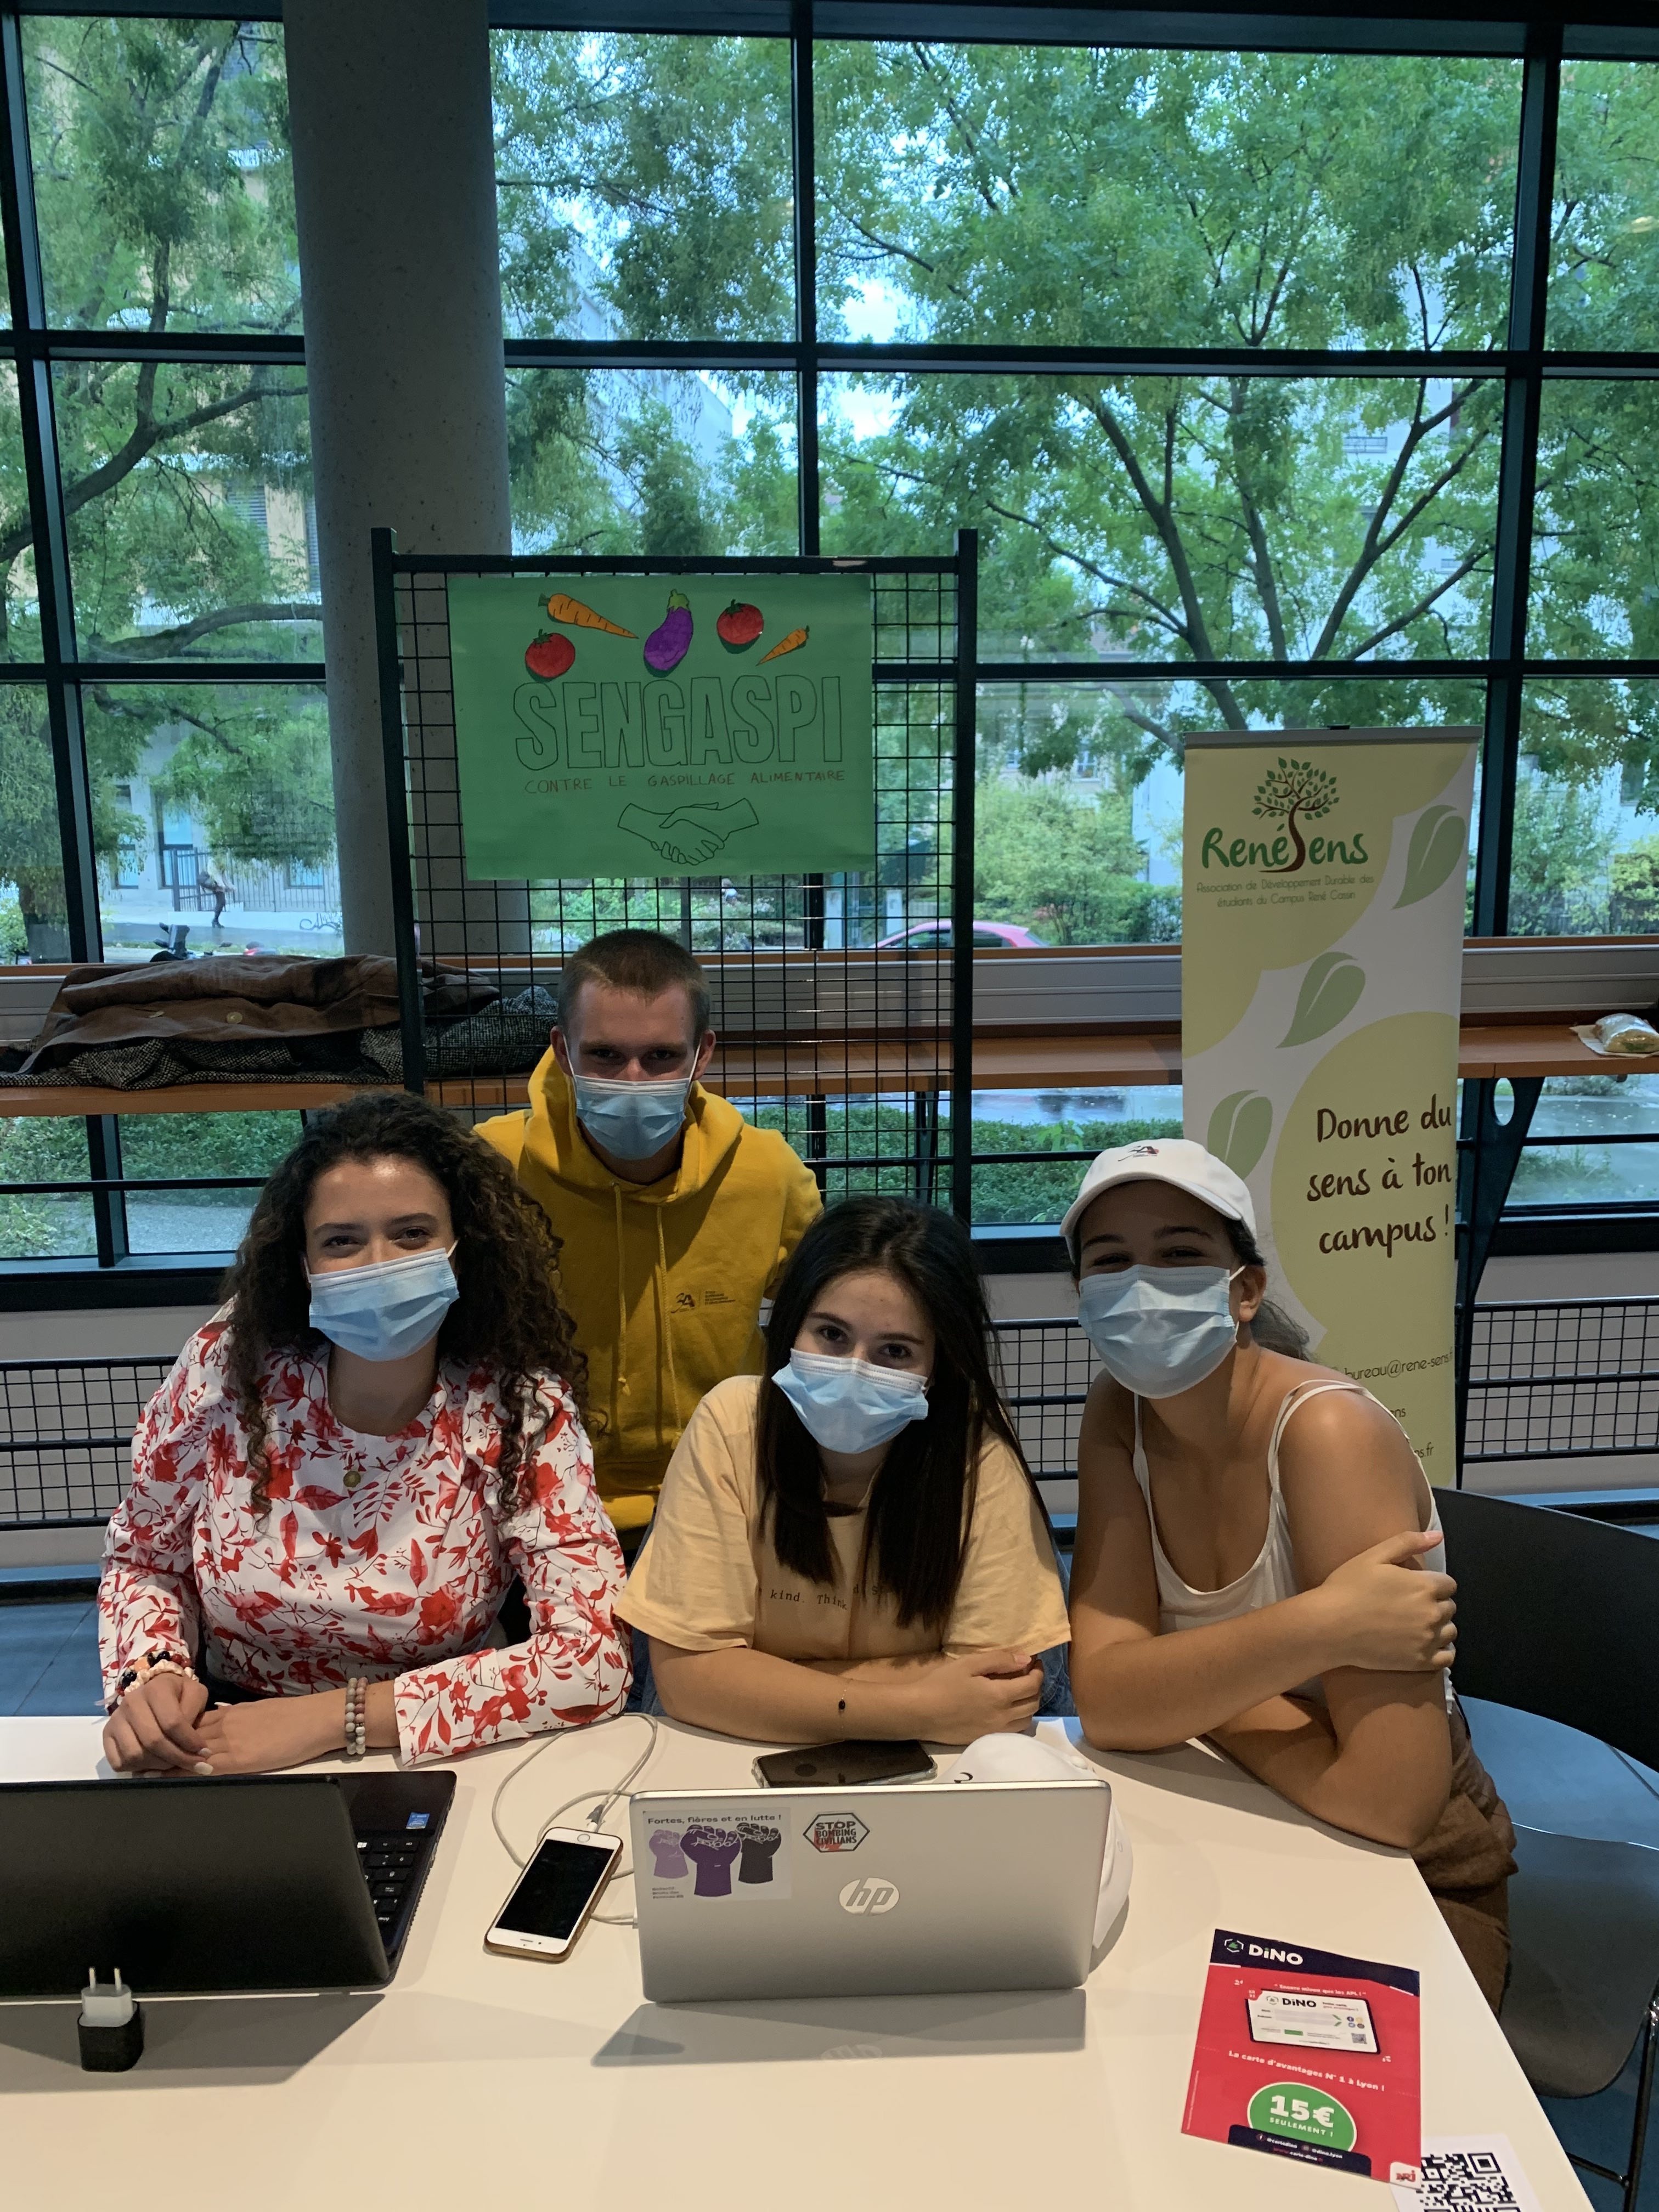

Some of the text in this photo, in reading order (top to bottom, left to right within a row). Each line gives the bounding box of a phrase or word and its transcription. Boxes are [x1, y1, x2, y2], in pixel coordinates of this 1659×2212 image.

[514, 675, 842, 770] SENGASPI
[524, 778, 593, 794] CONTRE
[608, 776, 627, 787] LE
[648, 772, 736, 787] GASPILLAGE
[1197, 874, 1374, 893] Association de Développement Durable des
[1217, 889, 1356, 907] étudiants du Campus René Cassin
[1317, 1093, 1452, 1143] Donne du
[1307, 1153, 1453, 1201] sens à ton
[1319, 1204, 1449, 1258] campus !
[770, 1589, 805, 1604] kind.
[817, 1594, 848, 1610] Think
[816, 1821, 856, 1830] STOP
[816, 1829, 857, 1837] BOMBING
[816, 1836, 857, 1845] CIVILIANS
[845, 1877, 895, 1915] hp
[1242, 2054, 1265, 2064] carte
[1267, 2059, 1323, 2078] d'avantages
[1357, 2080, 1379, 2091] Lyon
[1270, 2095, 1335, 2128] 15€
[1269, 2117, 1325, 2137] SEULEMENT
